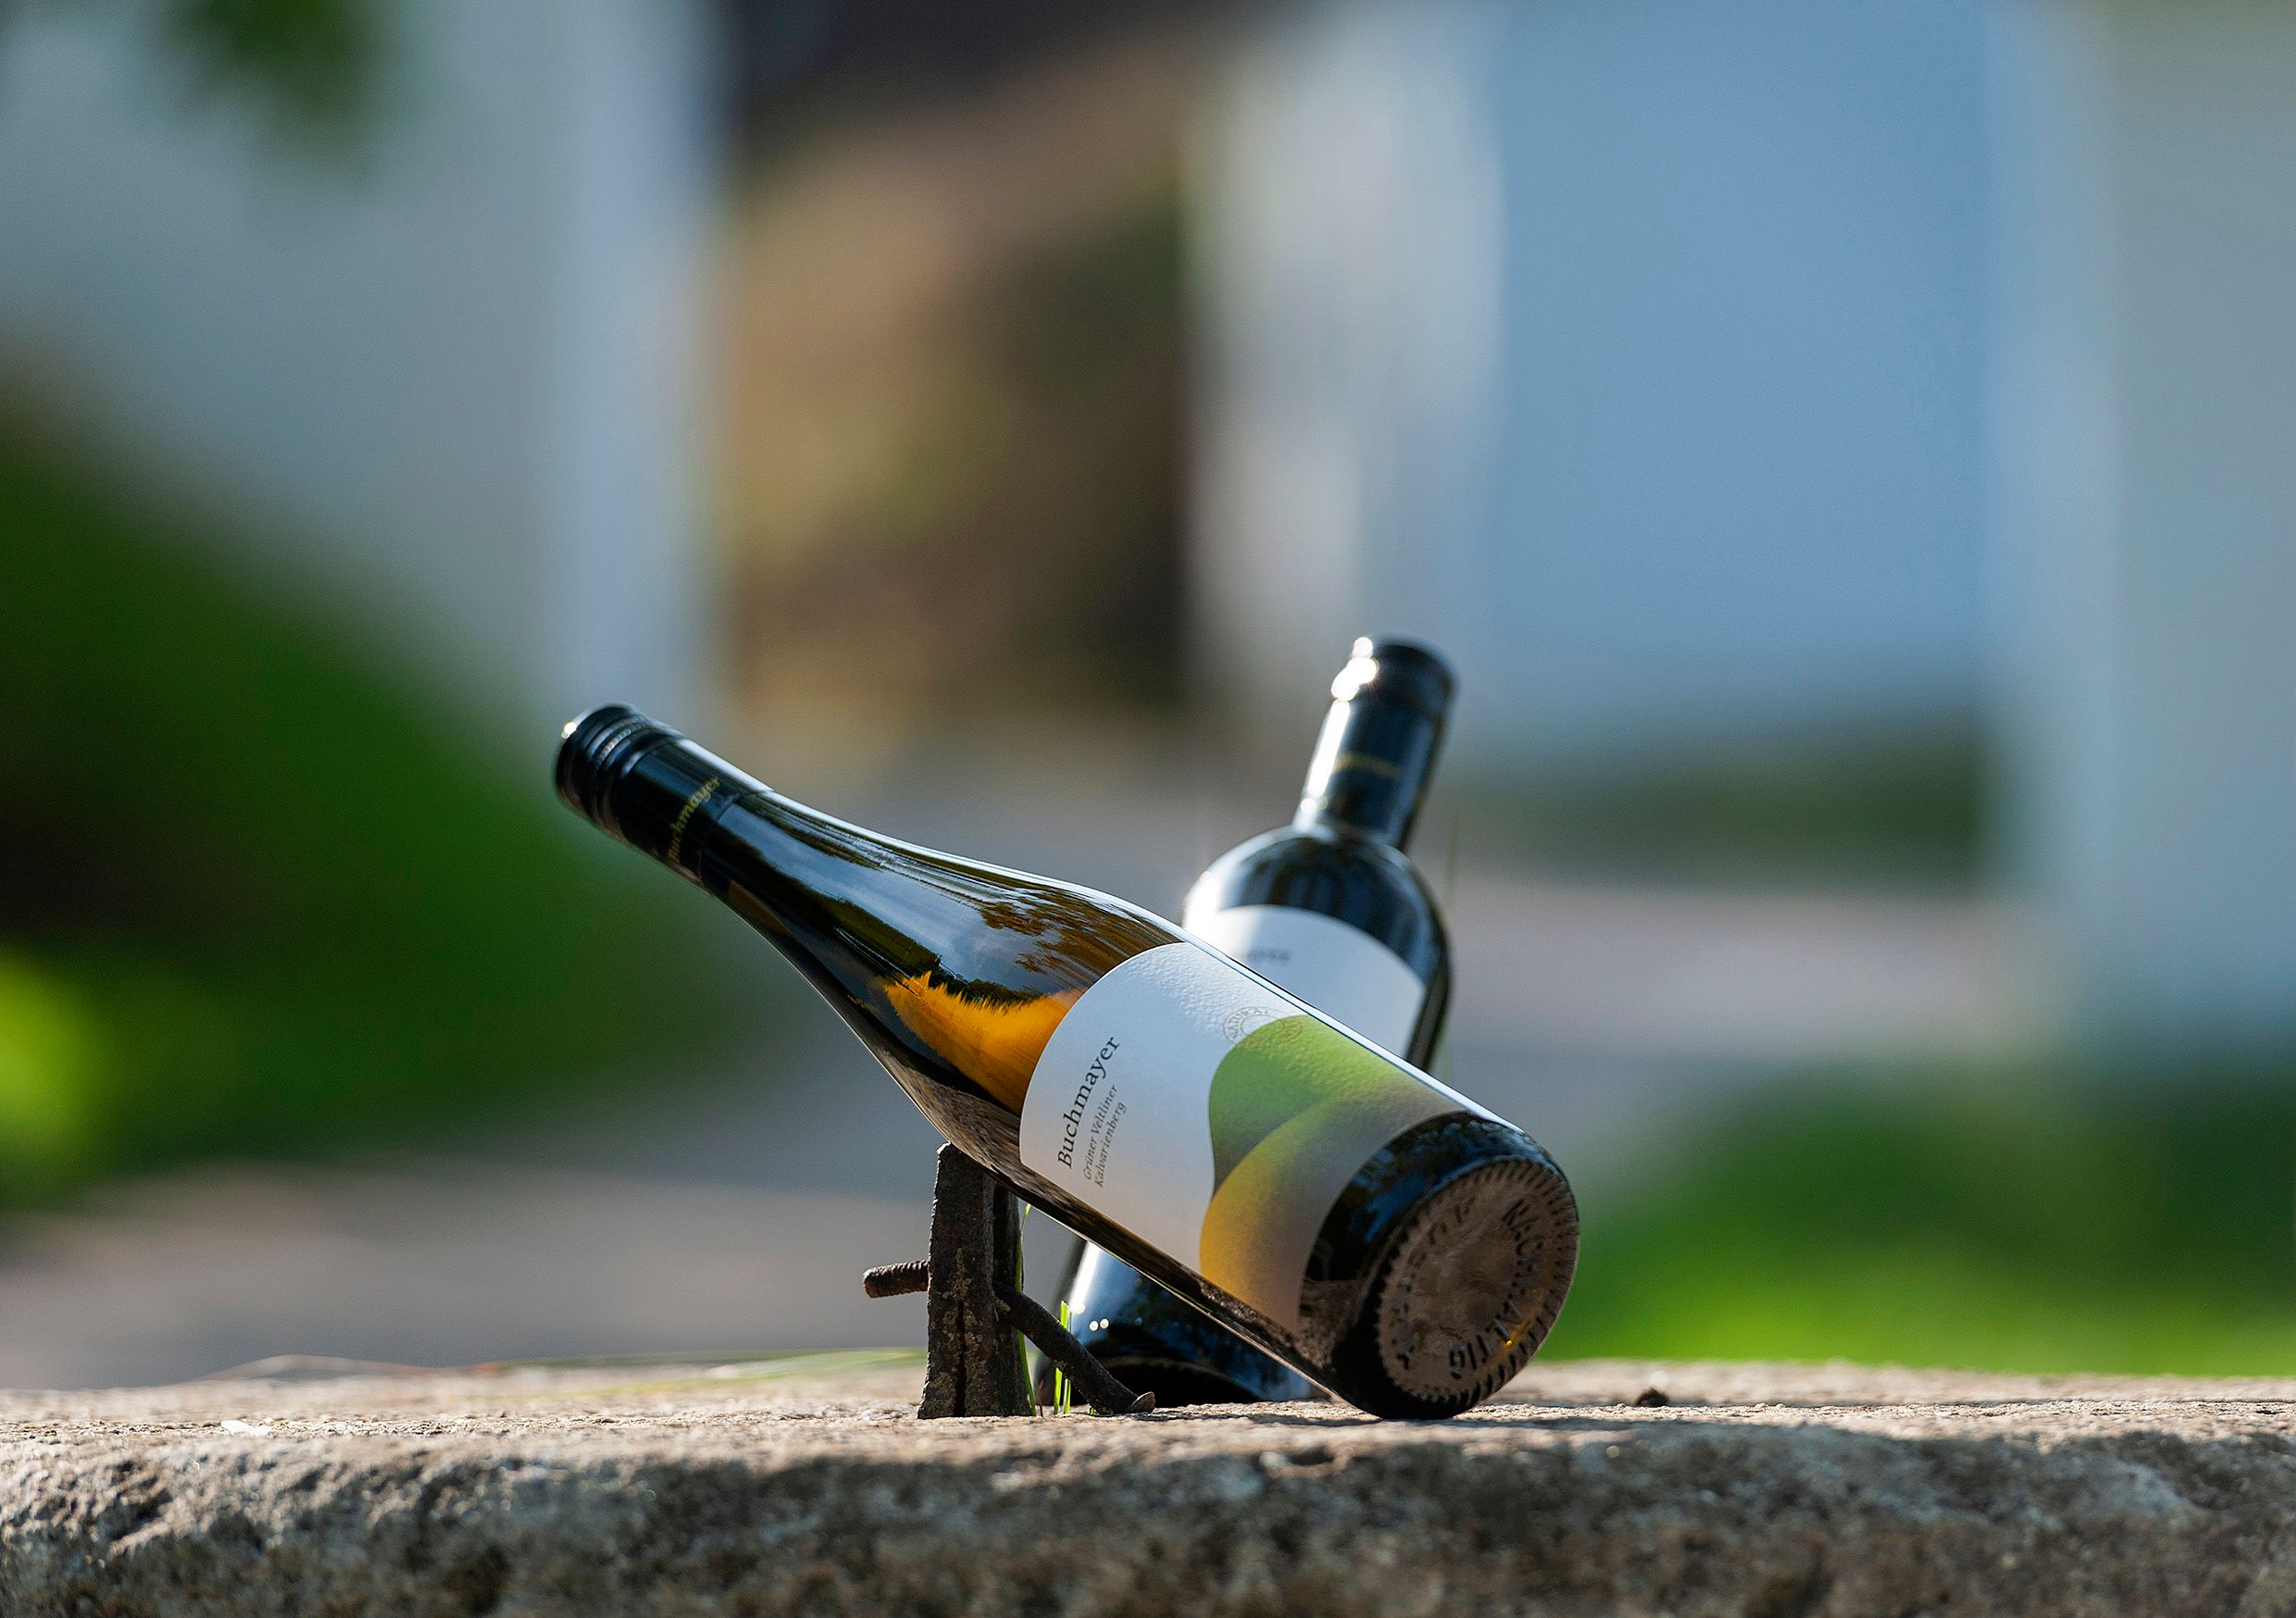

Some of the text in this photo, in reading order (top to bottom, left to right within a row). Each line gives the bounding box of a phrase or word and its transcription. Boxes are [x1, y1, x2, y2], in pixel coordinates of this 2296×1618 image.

[1058, 1037, 1120, 1169] Buchmayer
[1083, 1084, 1118, 1180] Grüner Veltliner
[1094, 1101, 1128, 1189] Kalvarienberg
